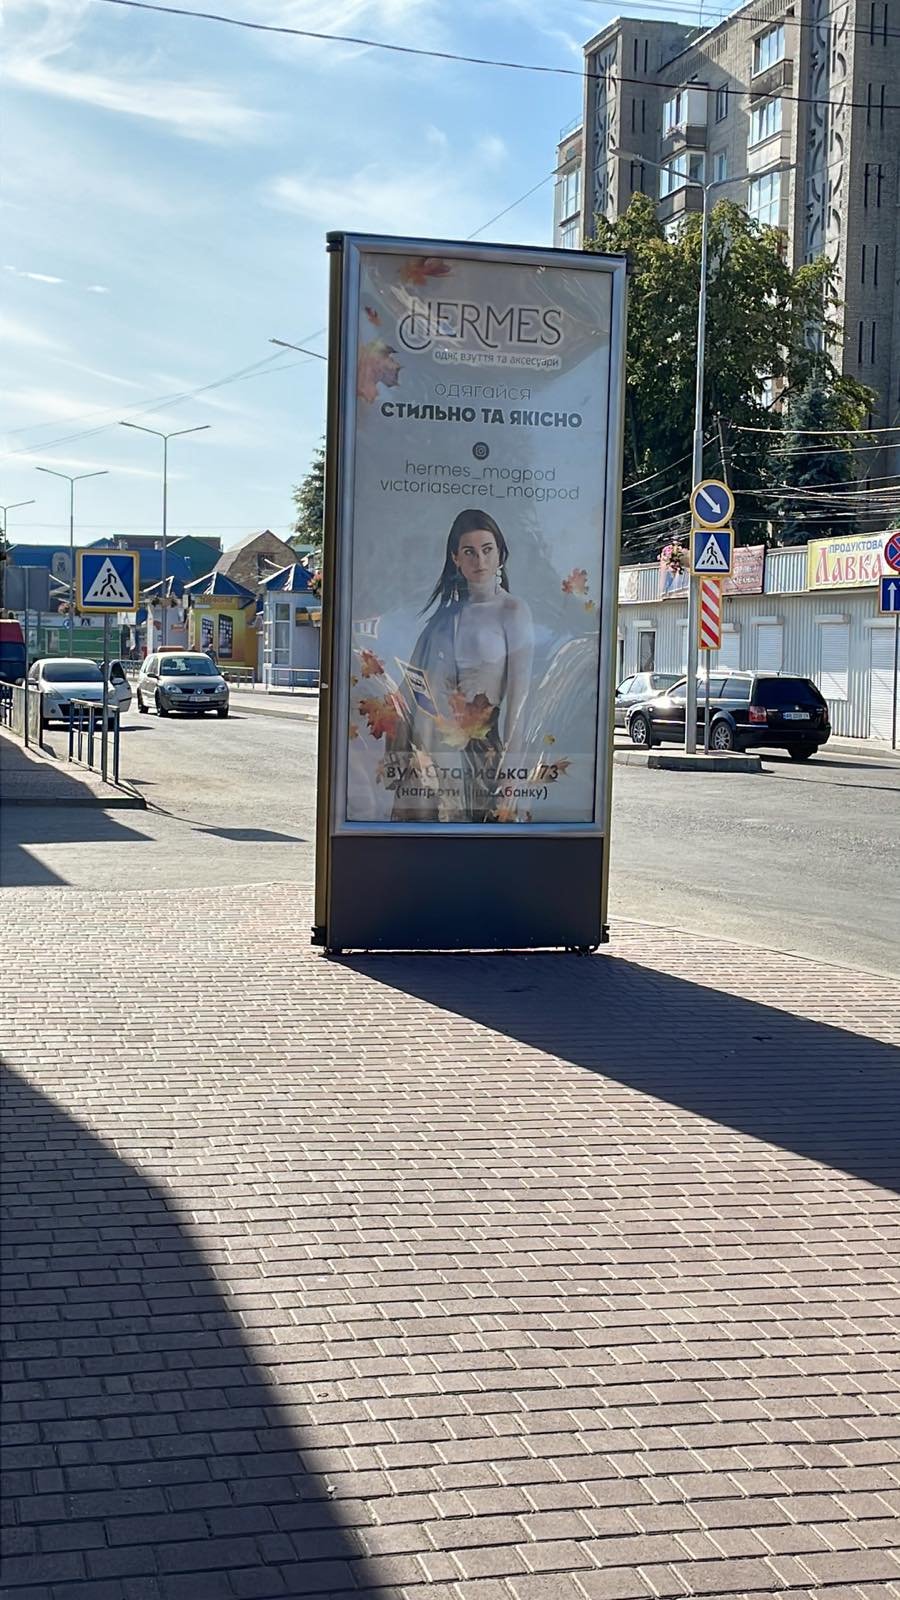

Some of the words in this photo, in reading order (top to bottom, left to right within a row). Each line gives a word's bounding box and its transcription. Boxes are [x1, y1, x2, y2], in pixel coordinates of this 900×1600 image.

[399, 300, 562, 350] HERMES
[460, 353, 494, 364] взуття
[497, 355, 507, 363] та
[509, 356, 559, 369] аксесуари
[434, 382, 531, 401] одягайся
[380, 402, 476, 423] СТИЛЬНО
[481, 408, 505, 425] ТА
[510, 410, 583, 428] ЯКІСНО
[405, 460, 556, 483] hermes_mogpod
[380, 477, 580, 501] victoriasecret_mogpod
[828, 540, 883, 553] ПРОДУКТОВА
